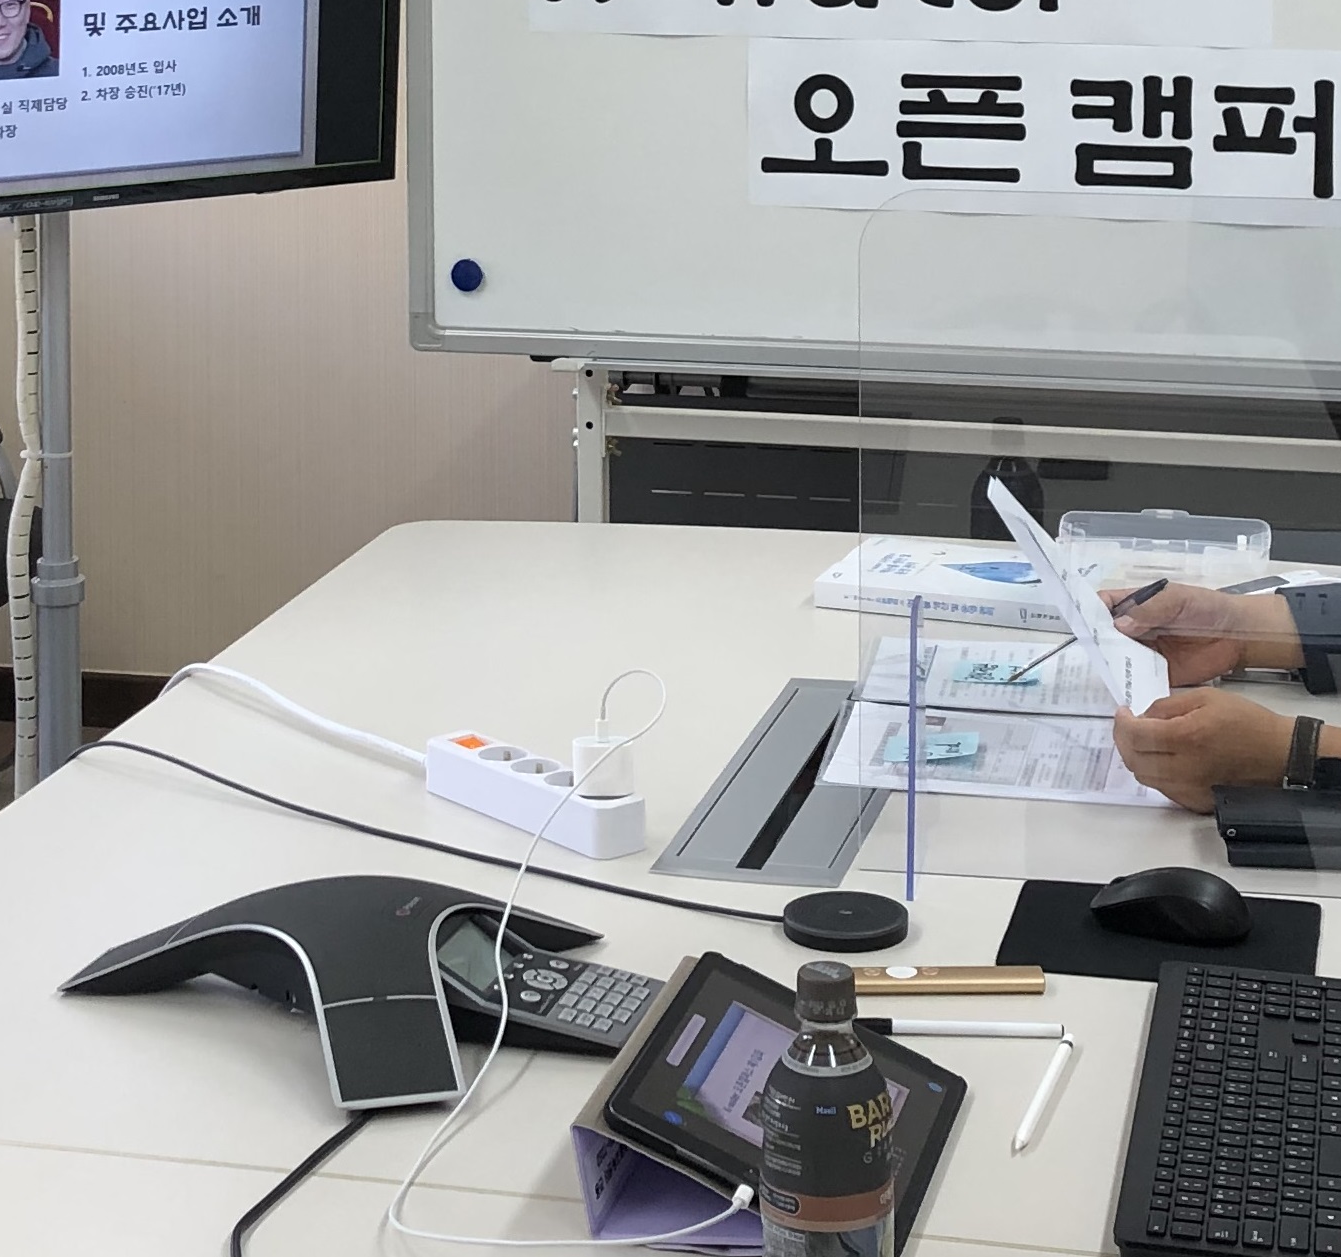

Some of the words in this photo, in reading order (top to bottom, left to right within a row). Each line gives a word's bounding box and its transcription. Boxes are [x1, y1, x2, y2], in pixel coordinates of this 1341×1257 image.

[83, 11, 107, 37] 및
[115, 7, 208, 34] 주요사업
[216, 5, 262, 28] 소개
[82, 66, 92, 78] 1.
[96, 61, 149, 78] 2008년도
[153, 58, 177, 75] 입사
[81, 90, 92, 102] 2.
[96, 86, 120, 101] 차장
[18, 97, 68, 113] 직제담당
[760, 73, 1027, 183] 오픈
